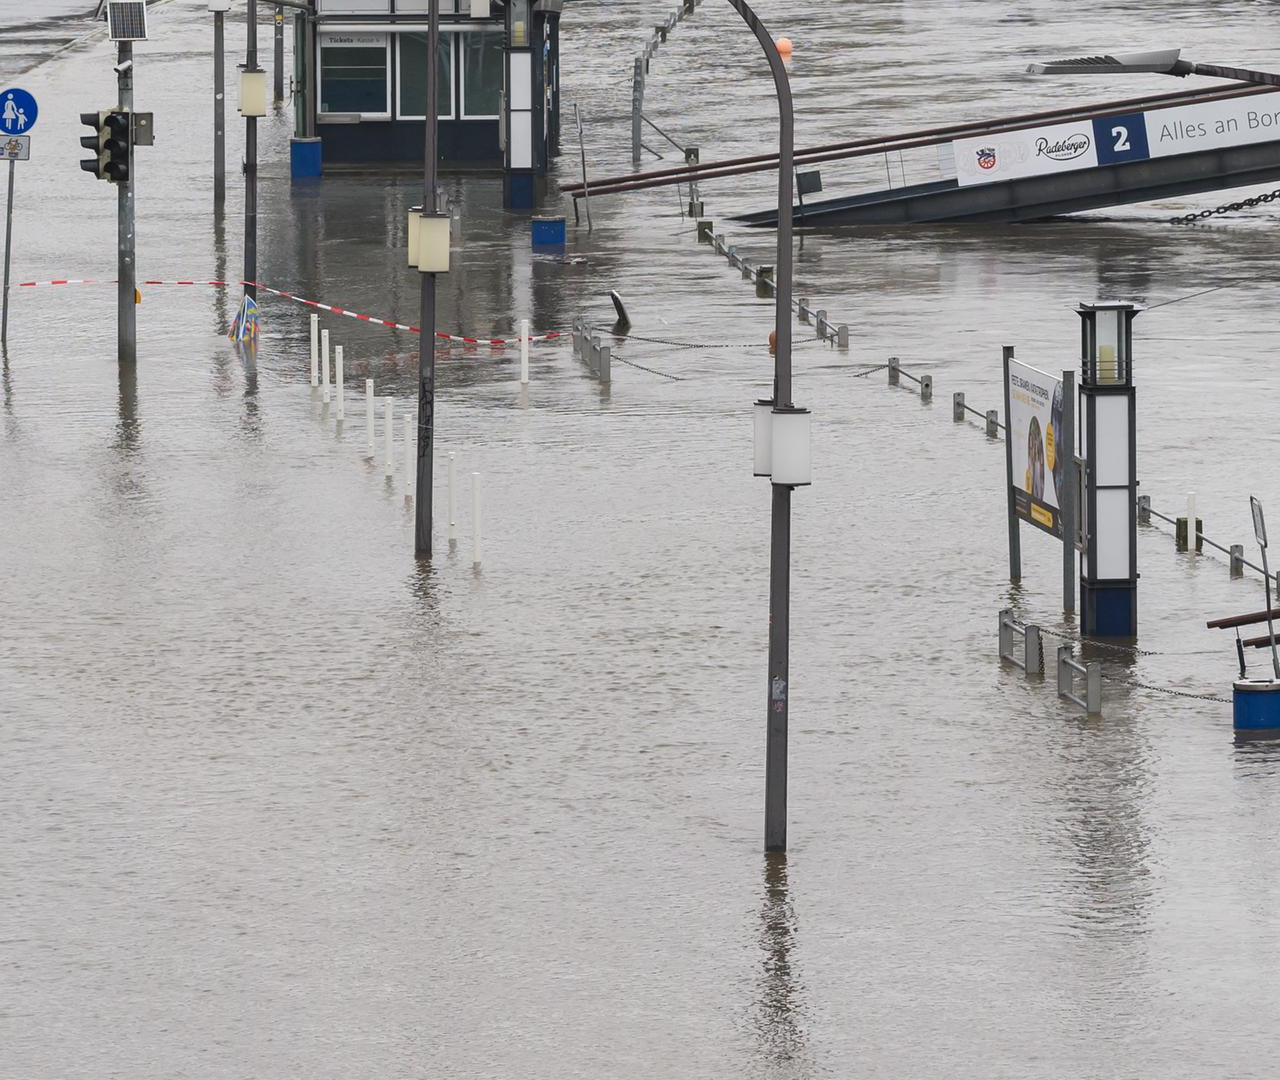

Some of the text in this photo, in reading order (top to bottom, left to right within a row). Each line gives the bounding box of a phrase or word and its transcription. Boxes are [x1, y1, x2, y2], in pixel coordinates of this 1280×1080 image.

[1111, 126, 1131, 152] 2
[1159, 121, 1207, 142] Alles
[1214, 117, 1238, 134] an
[1035, 133, 1090, 161] Radeberger
